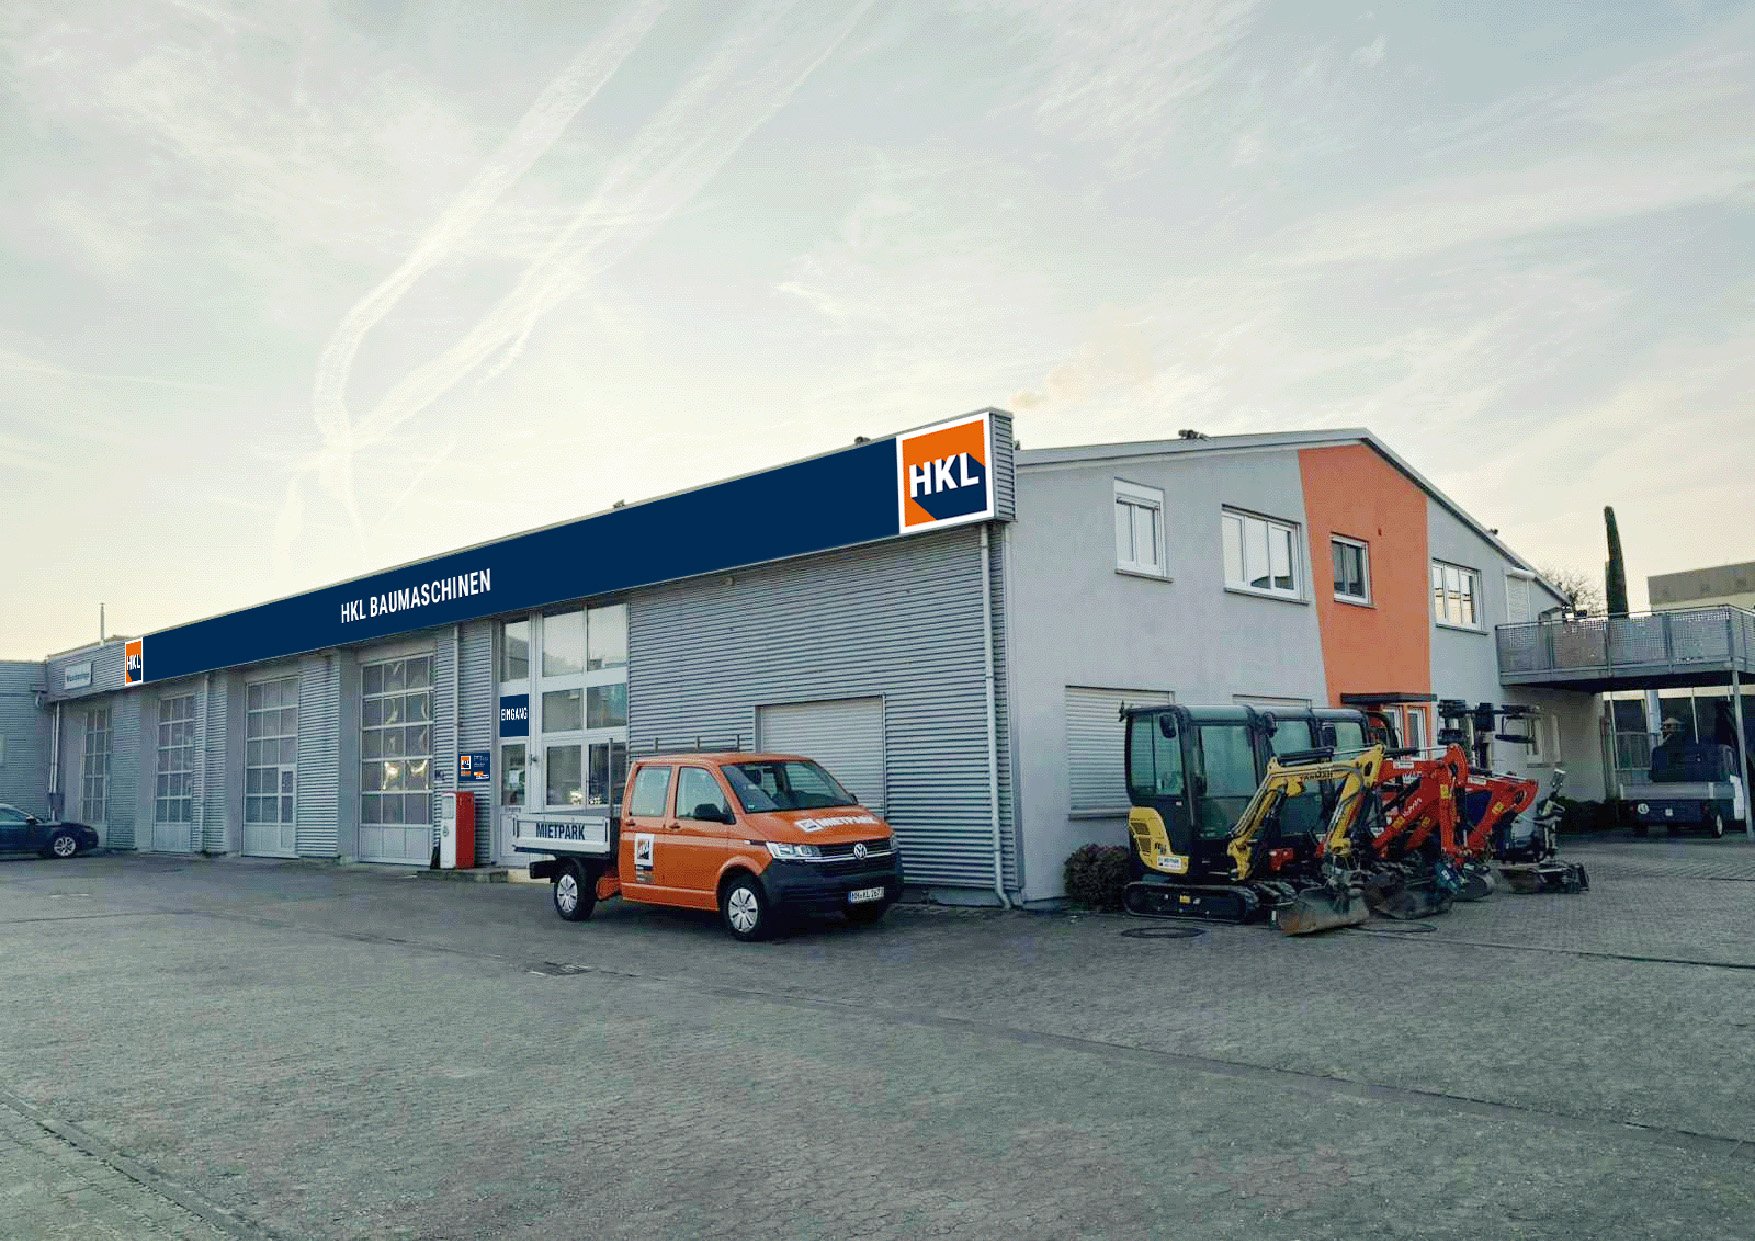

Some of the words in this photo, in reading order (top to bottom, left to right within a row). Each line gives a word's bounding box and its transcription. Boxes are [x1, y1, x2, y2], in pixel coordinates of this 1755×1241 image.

[908, 452, 979, 498] HKL
[341, 599, 366, 624] HKL
[370, 568, 491, 618] BAUMASCHINEN
[126, 654, 141, 671] HKL
[535, 824, 586, 840] MIETPARK
